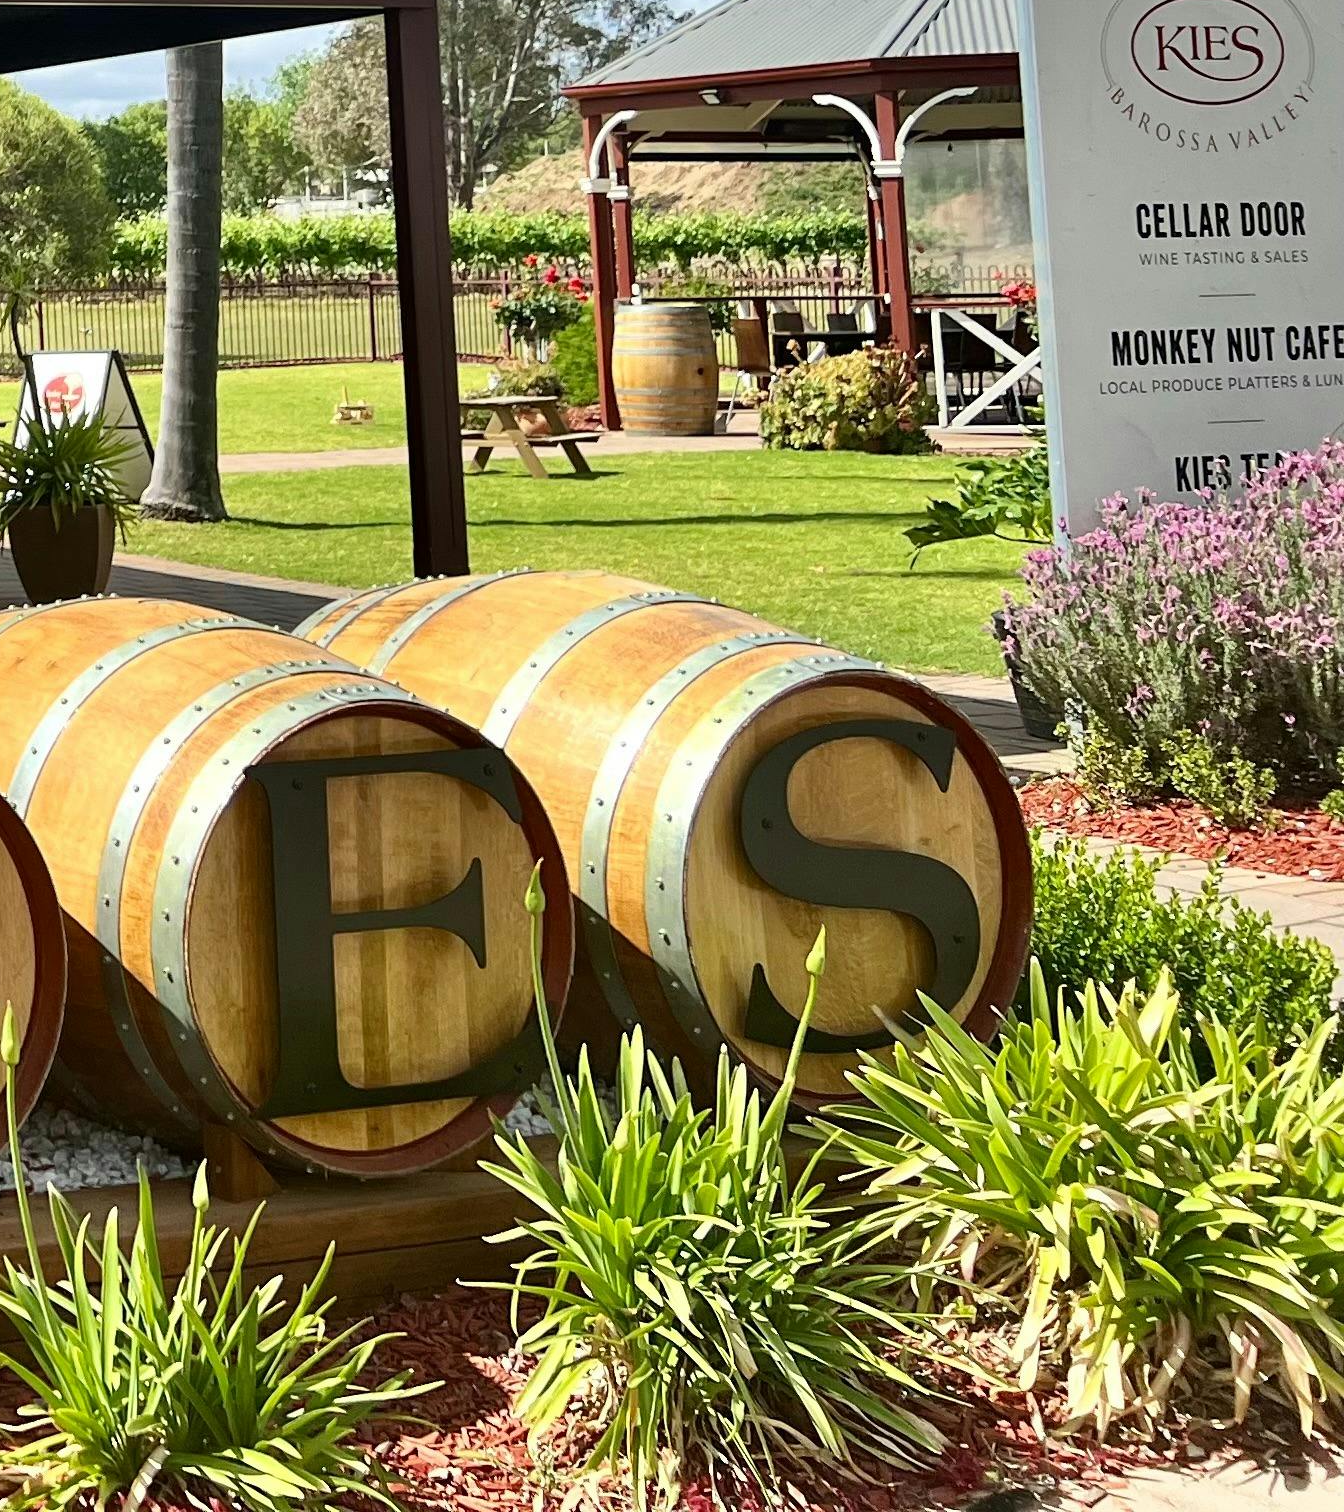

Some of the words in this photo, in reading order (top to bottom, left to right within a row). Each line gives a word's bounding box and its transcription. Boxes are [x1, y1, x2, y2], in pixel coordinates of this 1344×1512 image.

[1154, 25, 1264, 81] KIES
[1111, 87, 1218, 153] BAROSSA
[1229, 85, 1310, 151] VALLEY
[1135, 202, 1231, 239] CELLAR
[1240, 201, 1306, 237] DOOR
[1139, 252, 1179, 266] WINE
[1184, 251, 1246, 265] TASTING
[1250, 251, 1260, 264] &
[1265, 250, 1309, 263] SALES
[1111, 328, 1216, 367] MONKEY
[1226, 326, 1275, 363] NUT
[1285, 324, 1344, 361] CAFE
[1099, 380, 1148, 396] LOCAL
[1152, 377, 1224, 393] PRODUCE
[1228, 375, 1298, 390] PLATTERS
[1302, 374, 1311, 387] &
[1175, 454, 1232, 492] KIES
